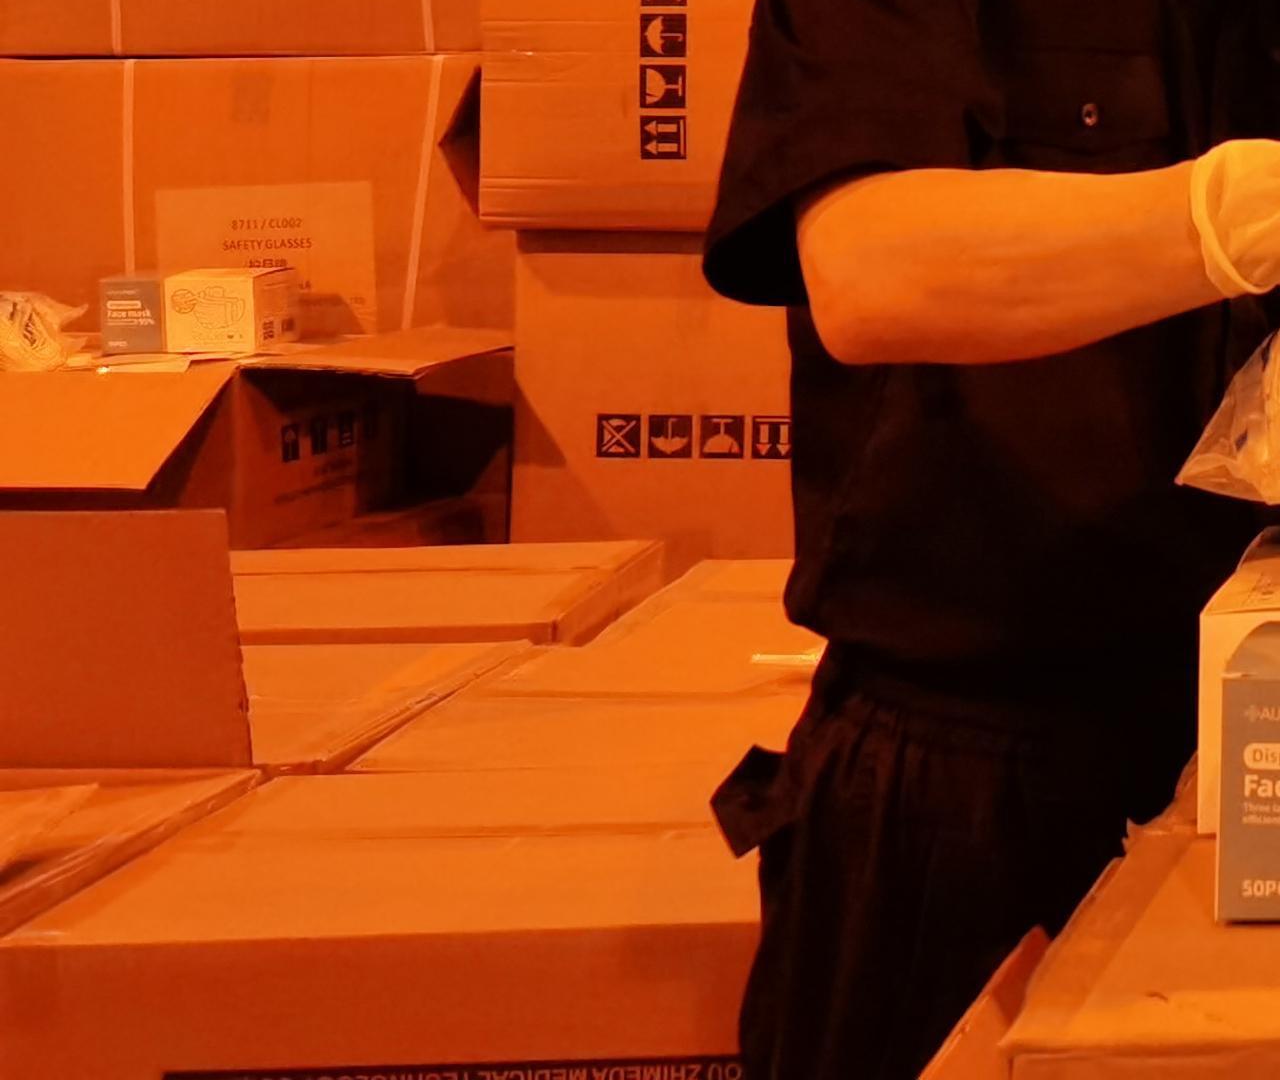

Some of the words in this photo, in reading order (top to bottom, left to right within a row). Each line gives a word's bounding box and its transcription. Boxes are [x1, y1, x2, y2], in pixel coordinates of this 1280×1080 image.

[231, 219, 258, 231] 8711
[223, 239, 262, 251] SAFETY
[265, 237, 312, 250] GLASSES
